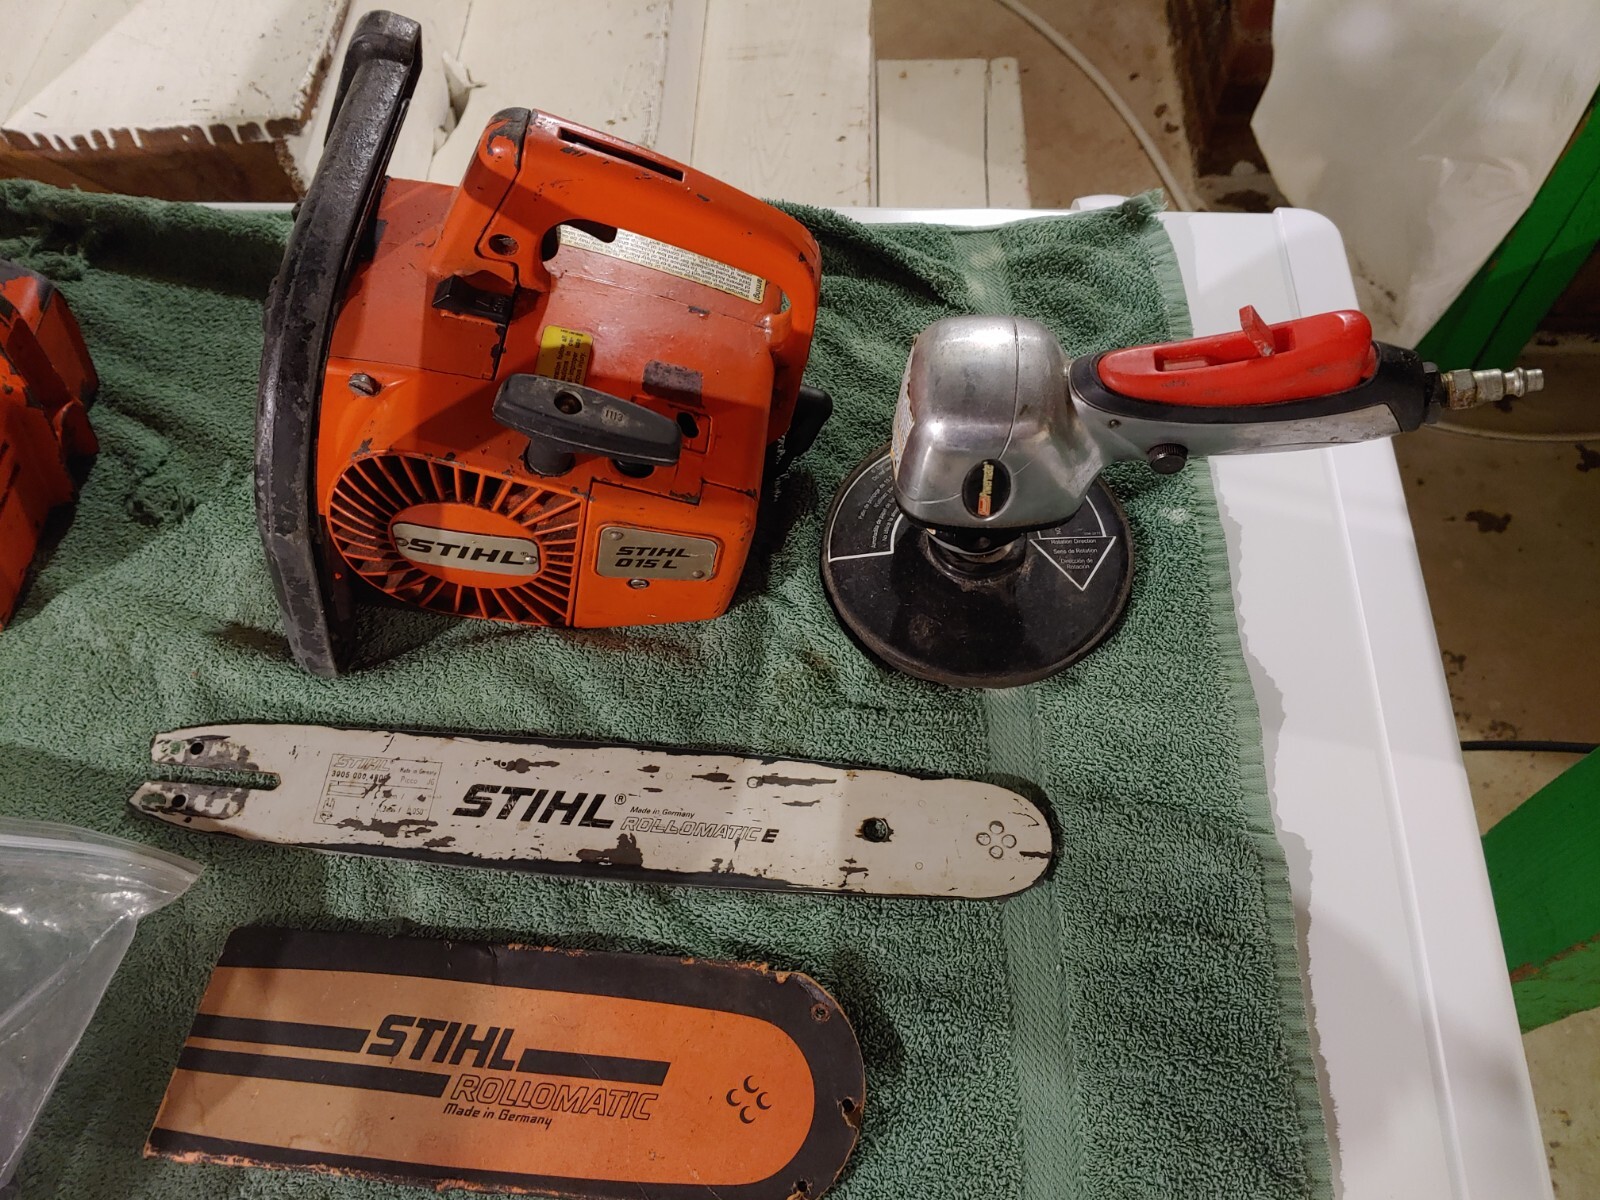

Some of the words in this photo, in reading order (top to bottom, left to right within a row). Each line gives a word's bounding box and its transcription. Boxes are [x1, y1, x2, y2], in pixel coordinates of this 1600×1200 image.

[752, 278, 763, 302] arning!
[605, 409, 624, 422] 1113
[407, 538, 526, 566] STIHL
[614, 558, 661, 569] 015
[662, 559, 678, 569] L
[615, 546, 691, 558] STIHL
[400, 776, 418, 785] Picco
[451, 783, 616, 829] STIHL
[629, 806, 651, 814] Made
[652, 807, 660, 815] in
[661, 808, 696, 819] Germany
[619, 816, 763, 842] ROLLOMATIC
[760, 828, 780, 843] E
[365, 1013, 518, 1072] STIHL
[450, 1073, 659, 1121] ROLLOMATIC
[443, 1102, 481, 1118] Made
[482, 1106, 495, 1119] in
[498, 1109, 553, 1131] Germany
